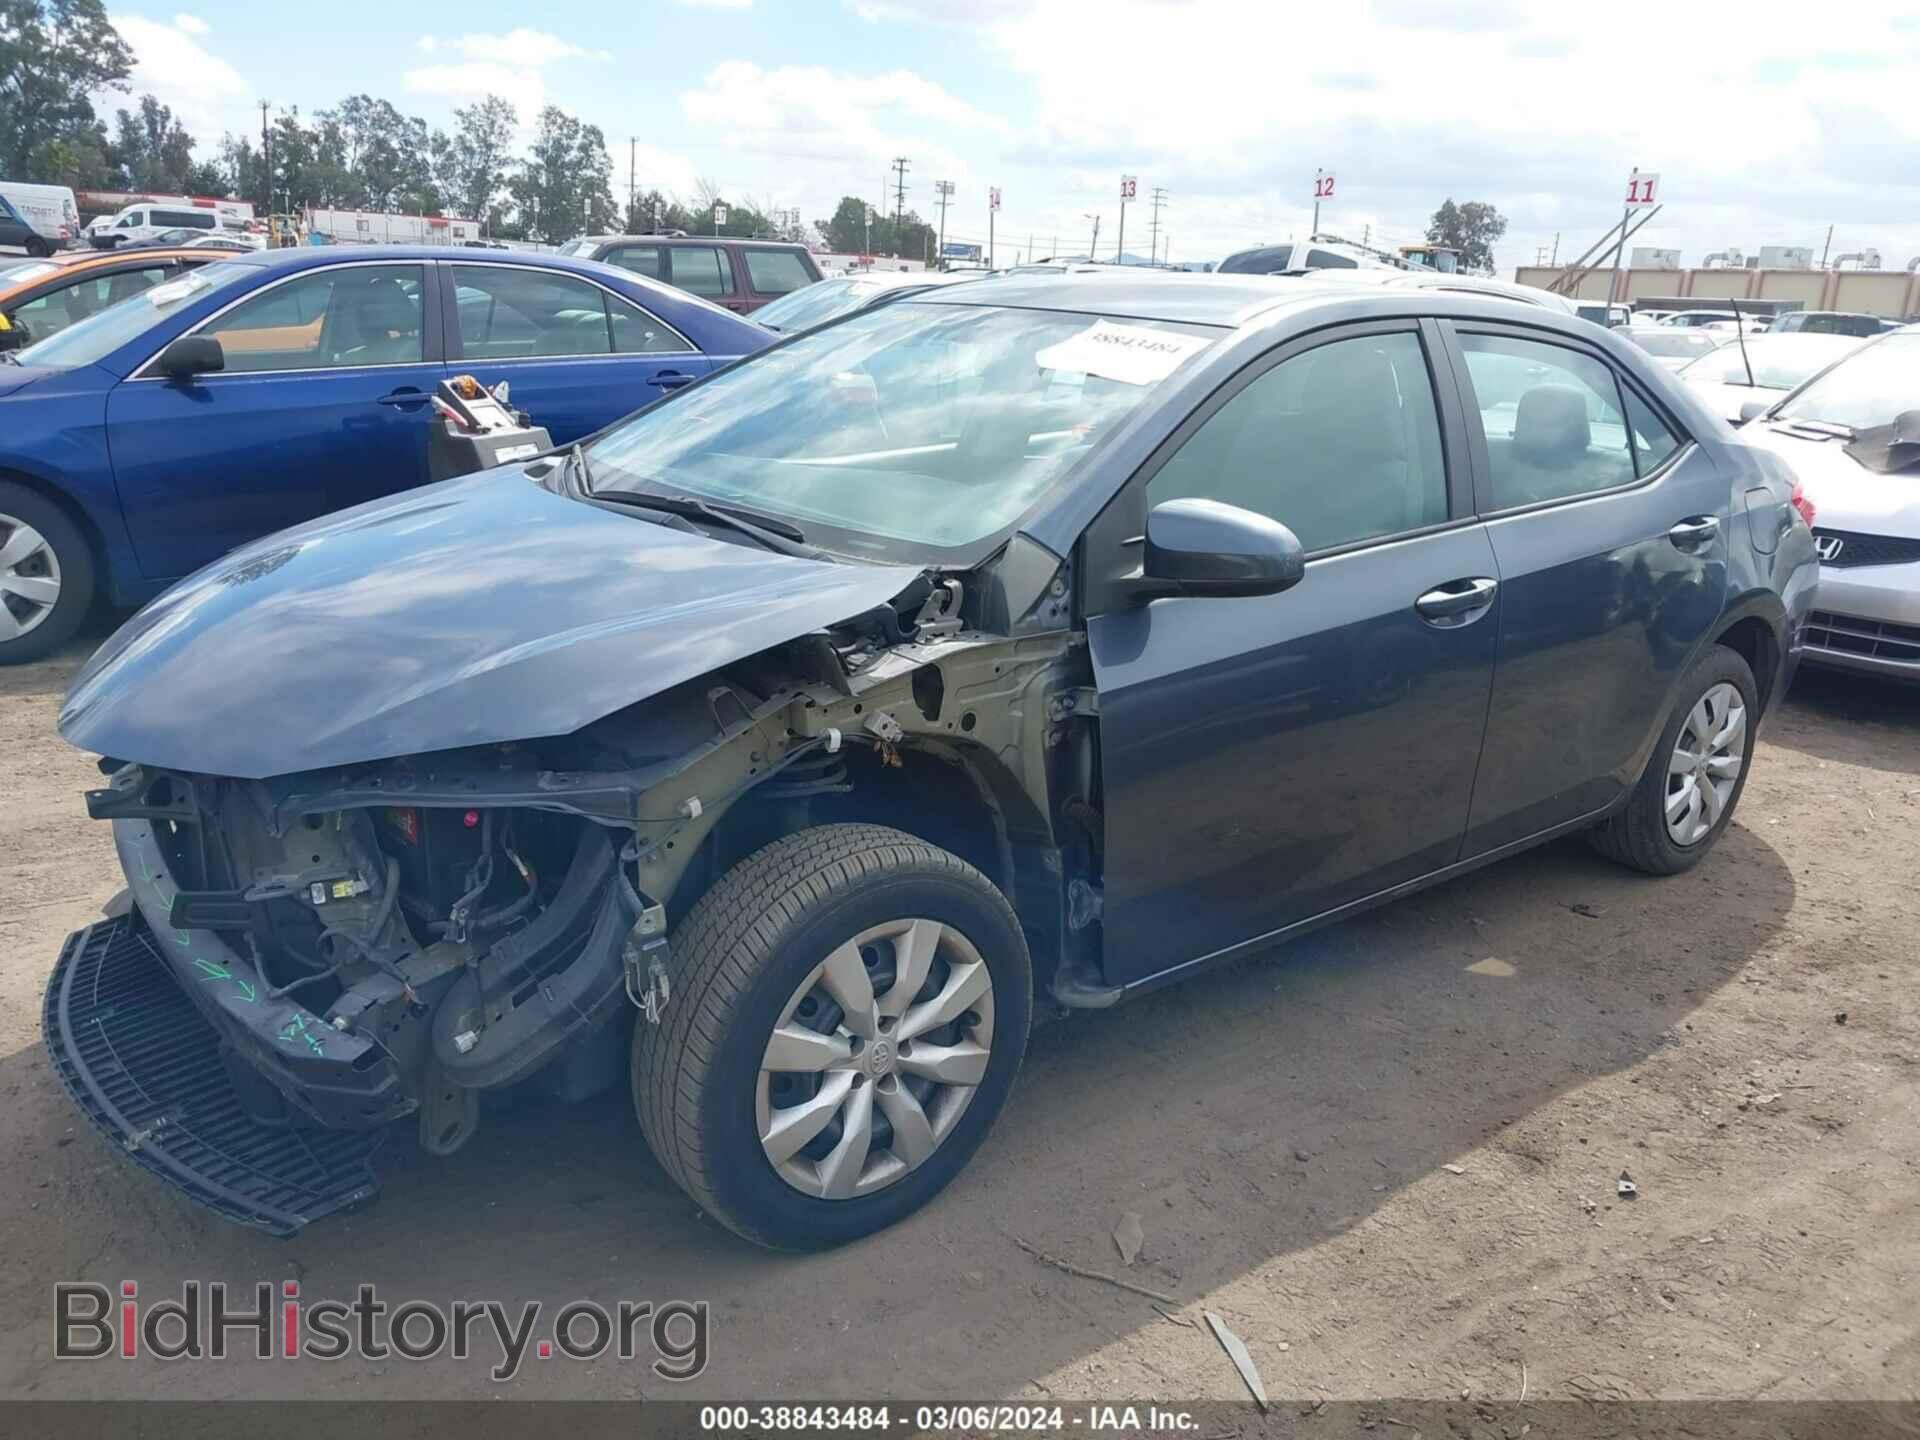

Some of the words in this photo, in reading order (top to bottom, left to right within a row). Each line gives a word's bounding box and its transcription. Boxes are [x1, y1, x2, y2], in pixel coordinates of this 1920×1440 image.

[1121, 180, 1136, 197] 13
[1314, 177, 1334, 197] 12
[1626, 180, 1654, 202] 11
